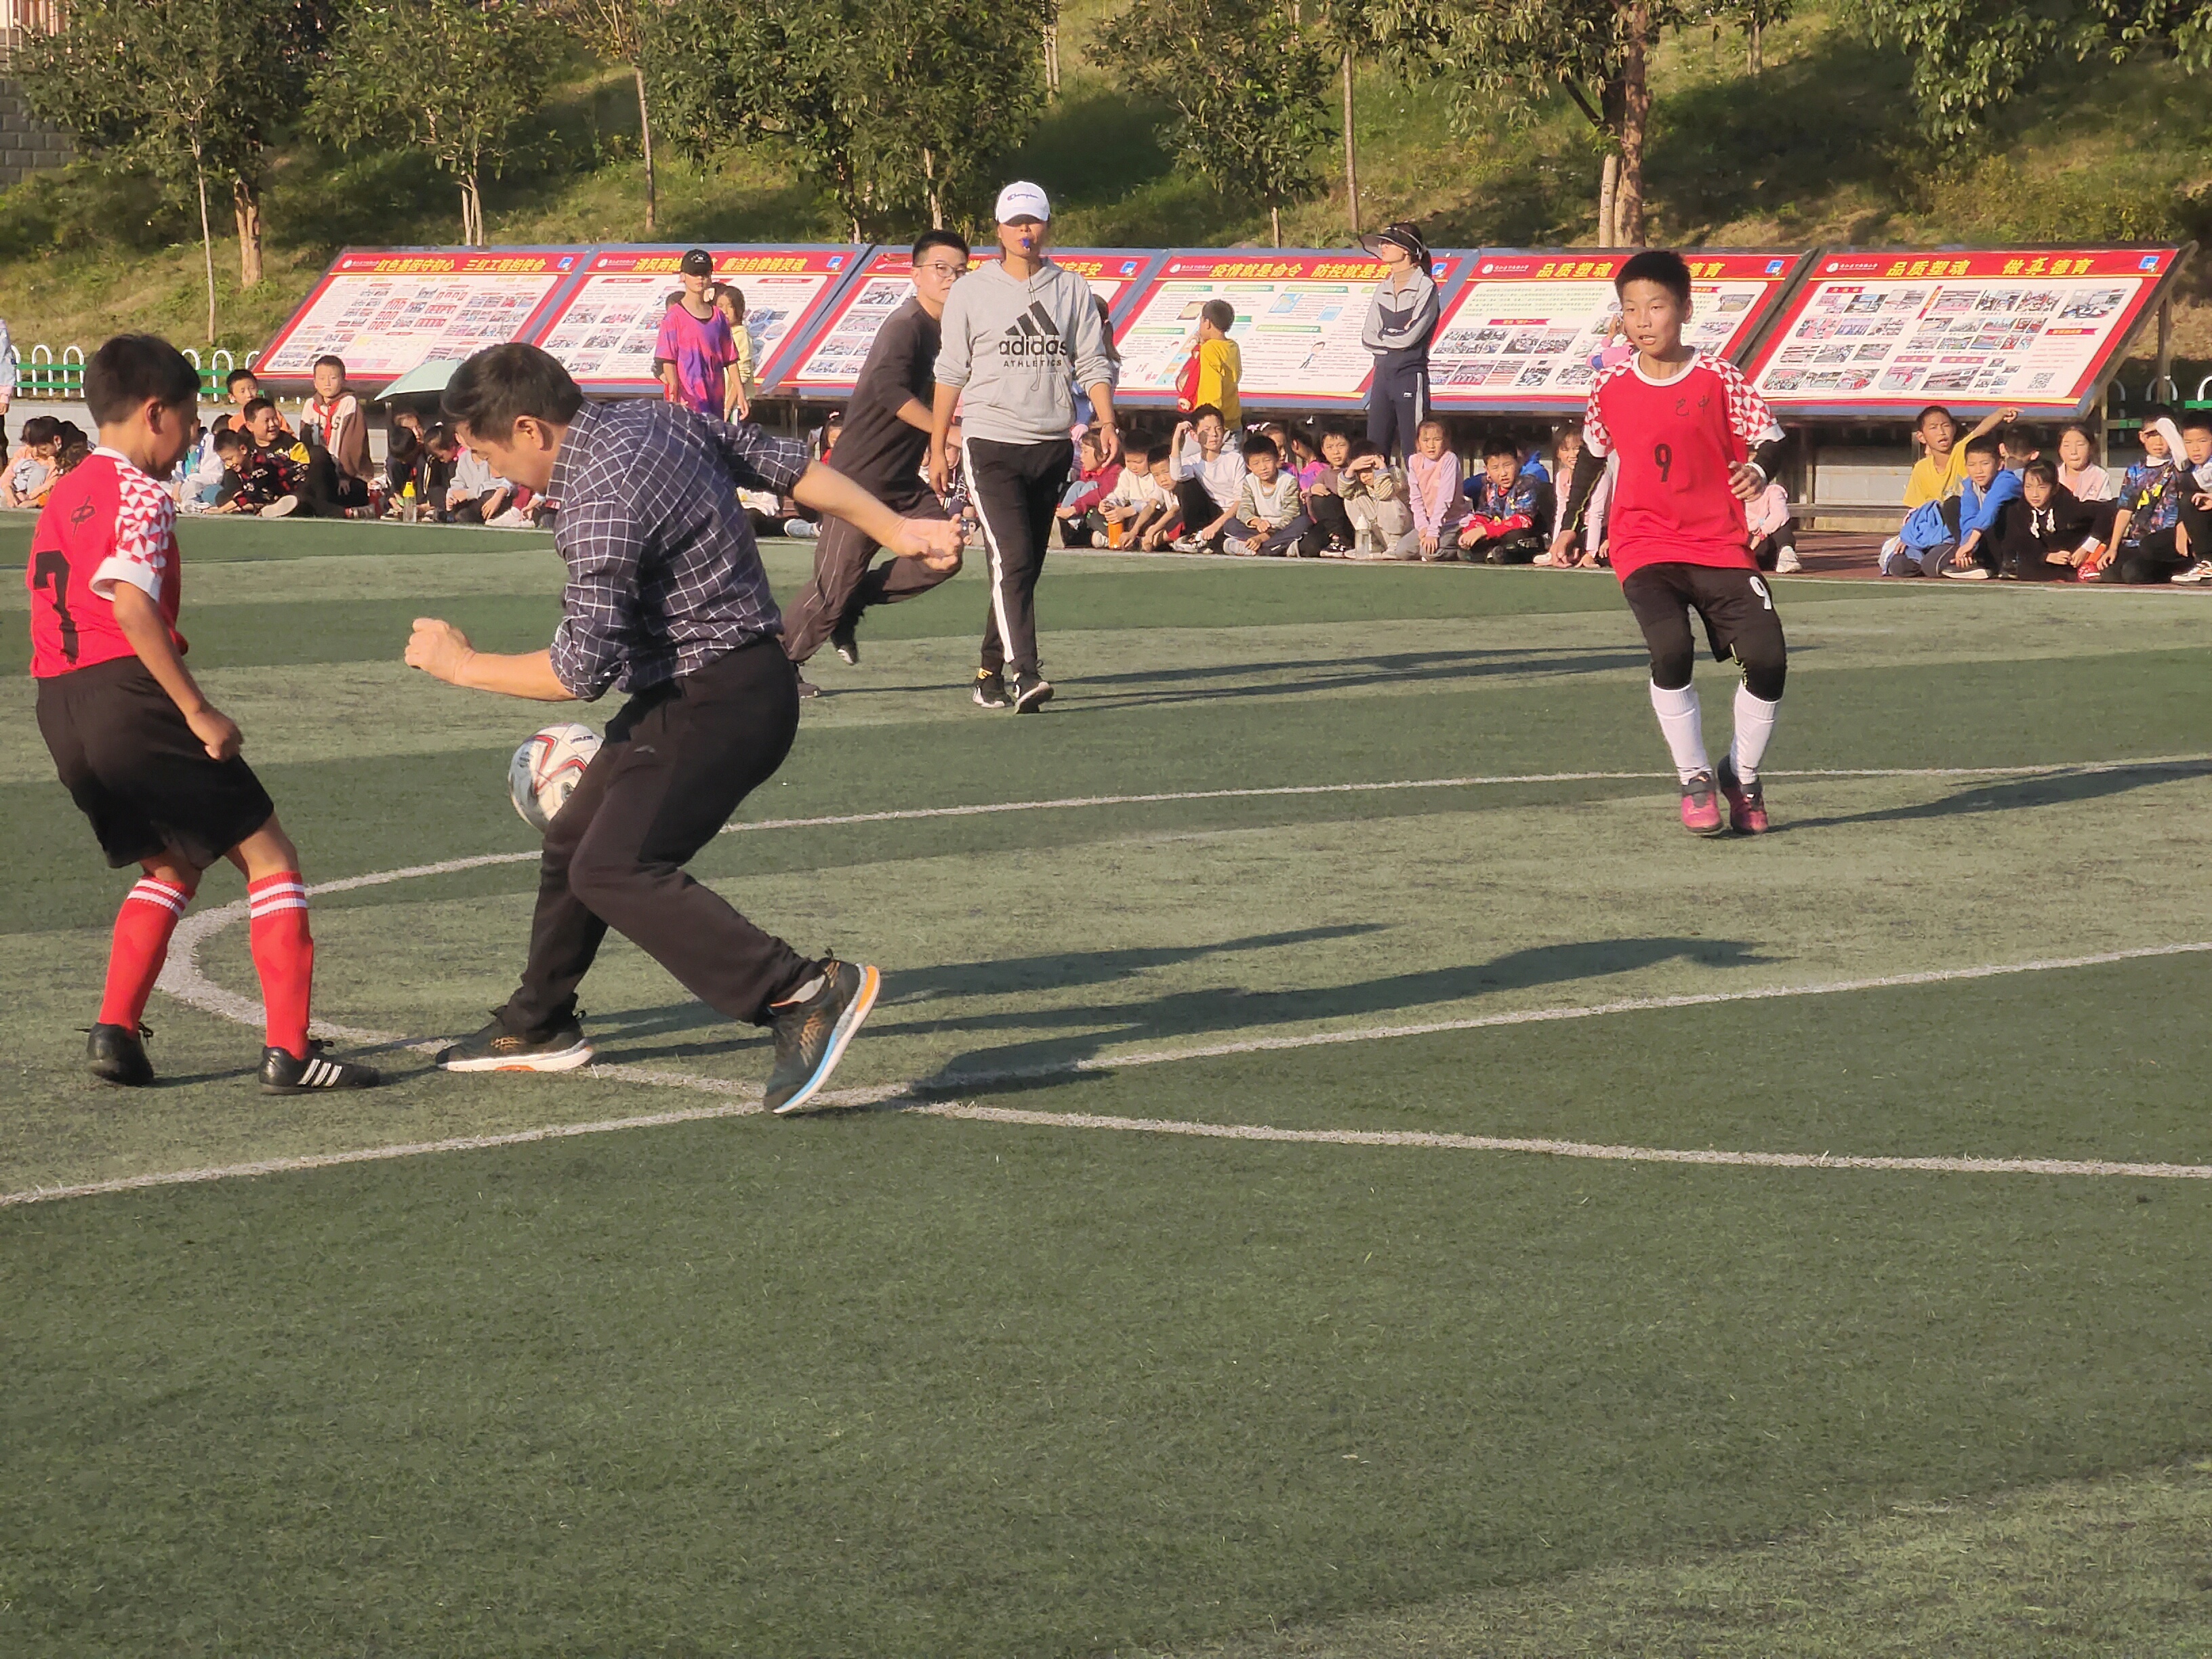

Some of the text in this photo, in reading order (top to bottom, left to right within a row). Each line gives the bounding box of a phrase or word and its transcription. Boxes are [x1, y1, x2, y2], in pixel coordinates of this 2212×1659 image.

[373, 259, 455, 272] 红色基因守初心
[1209, 263, 1303, 278] 疫情就是命令
[1311, 264, 1392, 279] 防控就是责
[1536, 262, 1614, 278] 品质塑魂
[1885, 260, 1971, 276] 品质塑魂
[2001, 258, 2095, 276] 做真德育
[998, 335, 1068, 356] adidas
[1654, 444, 1672, 483] 9
[1749, 576, 1772, 610] 9
[33, 550, 79, 664] 7
